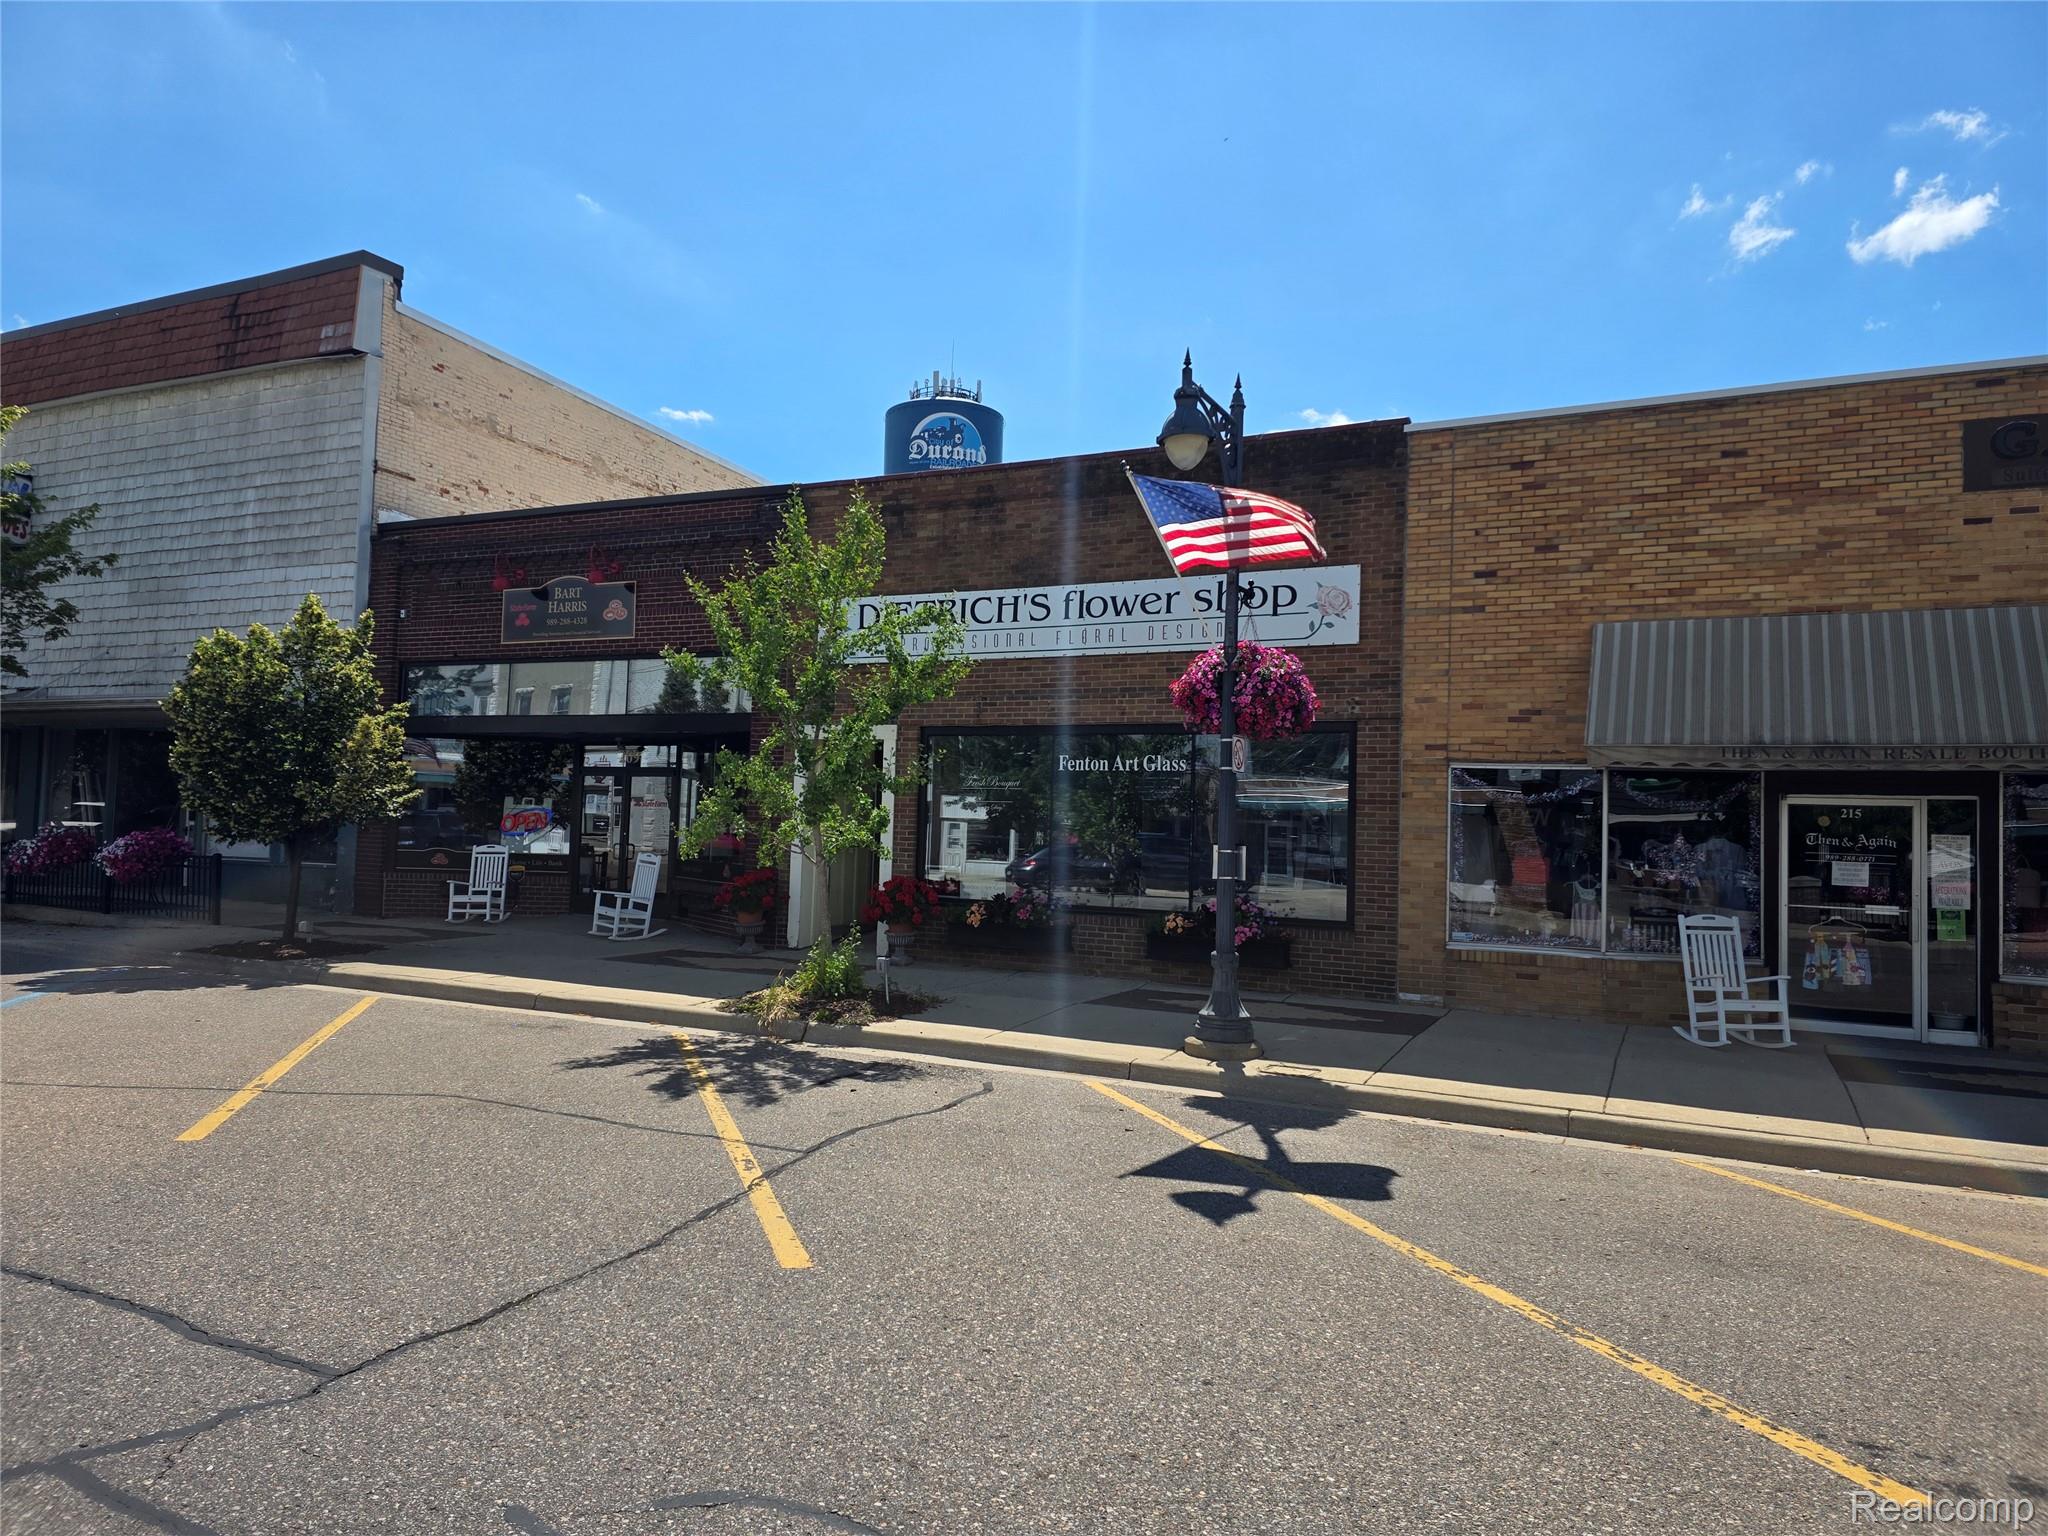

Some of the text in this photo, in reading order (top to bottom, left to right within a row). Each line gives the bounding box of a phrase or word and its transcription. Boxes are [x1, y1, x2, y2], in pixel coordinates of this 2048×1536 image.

[909, 438, 986, 465] Durand
[554, 587, 583, 599] BART
[548, 601, 587, 613] HARRIS
[1063, 588, 1180, 619] flower
[1721, 747, 1770, 759] THEN
[1782, 747, 1795, 759] &
[1808, 747, 1872, 759] AGAIN
[1884, 747, 1966, 759] RESALE
[1058, 754, 1187, 771] Fenton Art Glass
[1840, 808, 1862, 818] 215
[501, 812, 548, 833] OPEN
[1806, 832, 1897, 850] Then & Again
